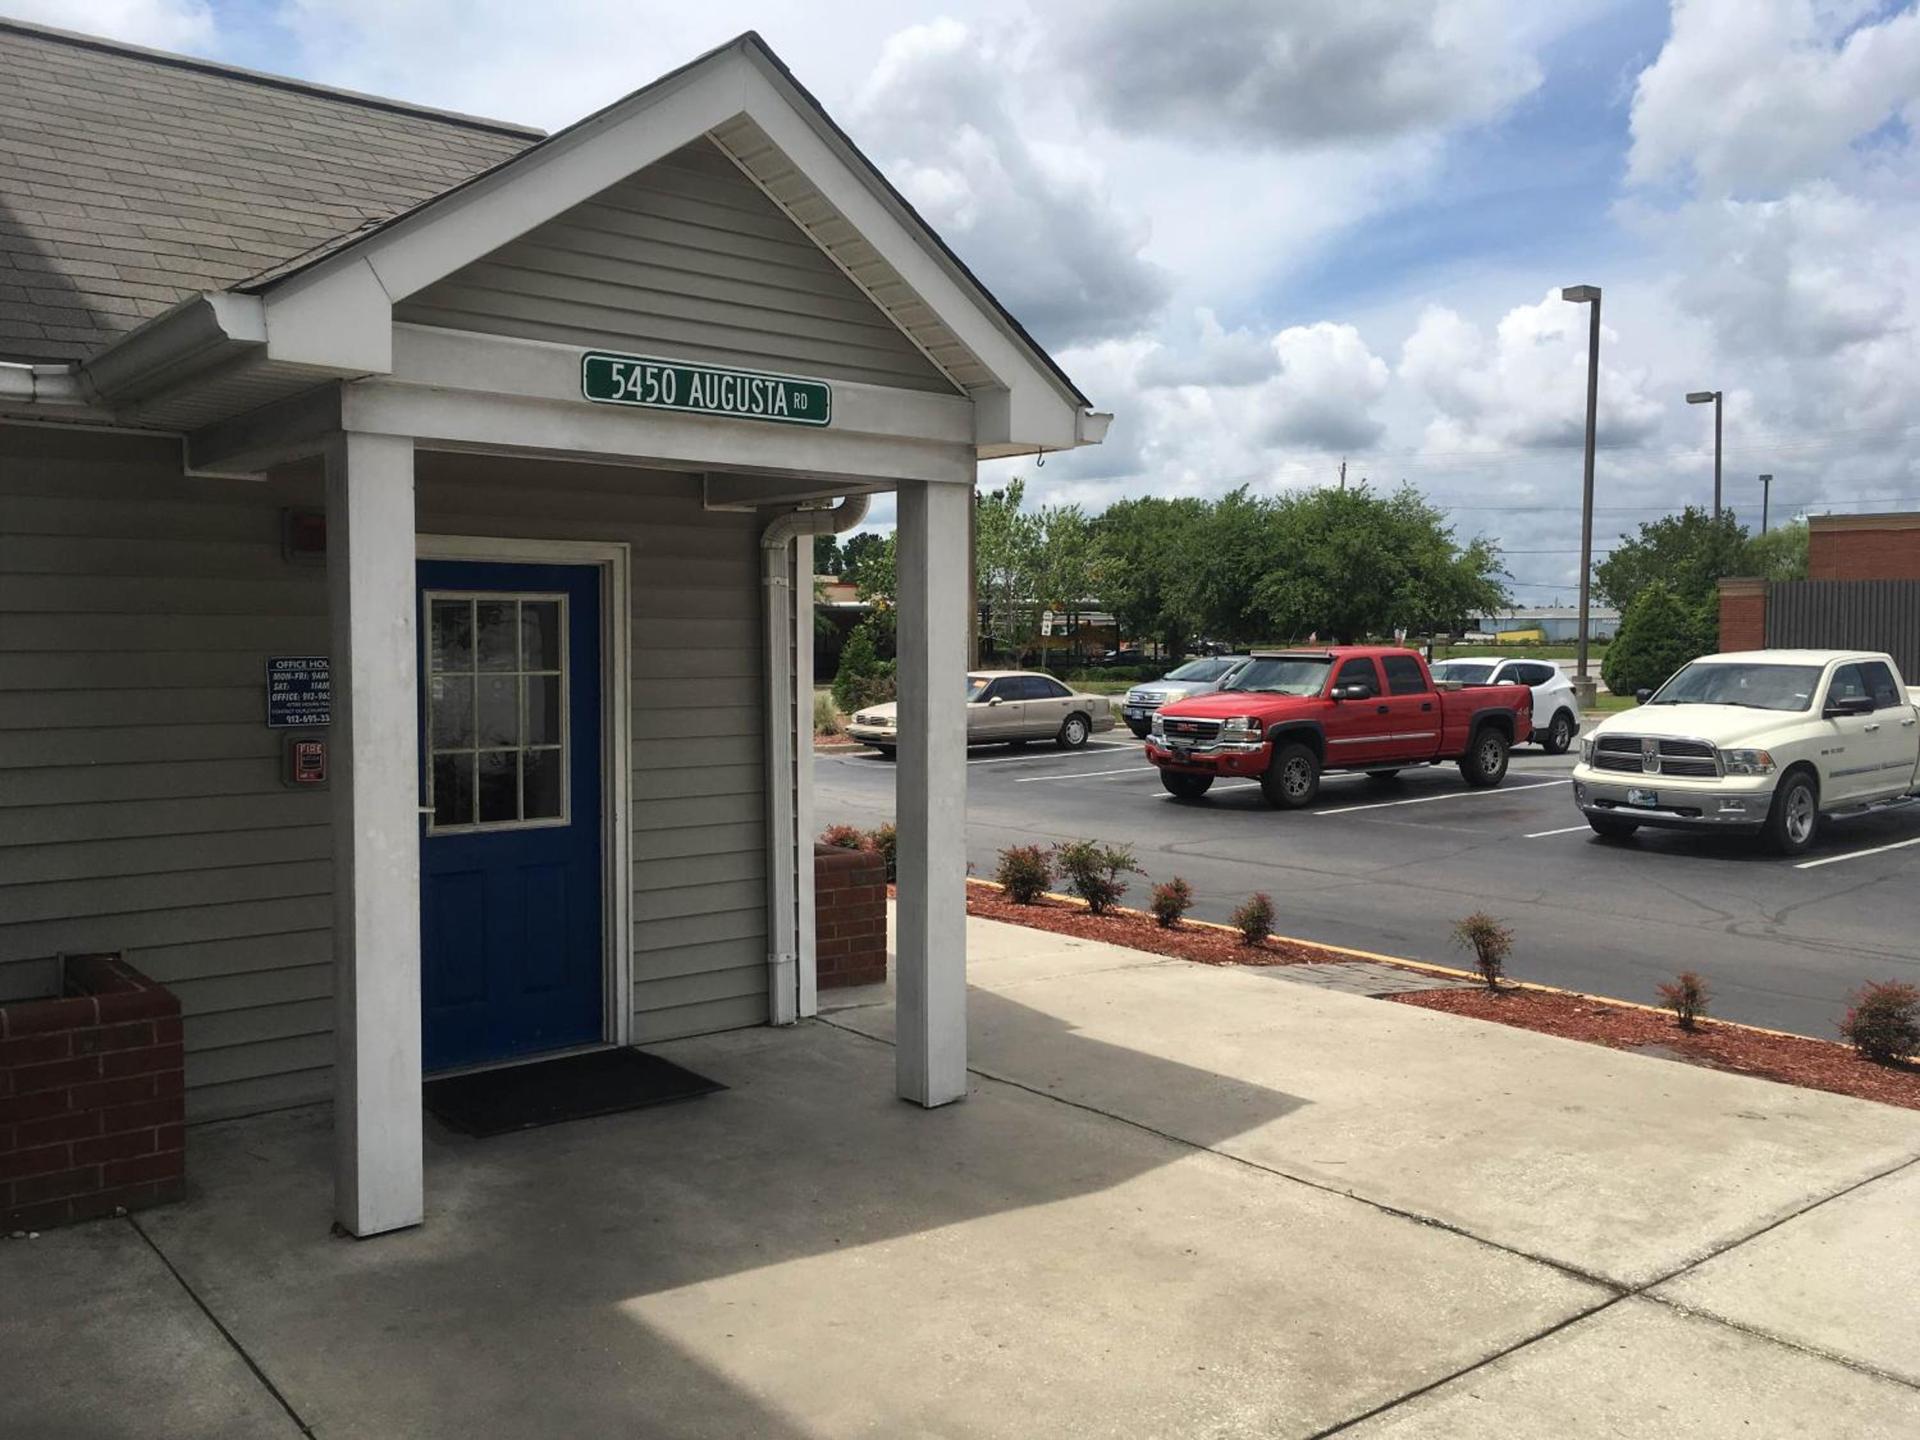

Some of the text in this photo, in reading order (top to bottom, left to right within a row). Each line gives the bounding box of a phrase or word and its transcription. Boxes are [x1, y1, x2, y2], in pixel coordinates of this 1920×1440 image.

[611, 363, 808, 415] 5450 AUGUSTA RD
[276, 660, 306, 669] OFFICE
